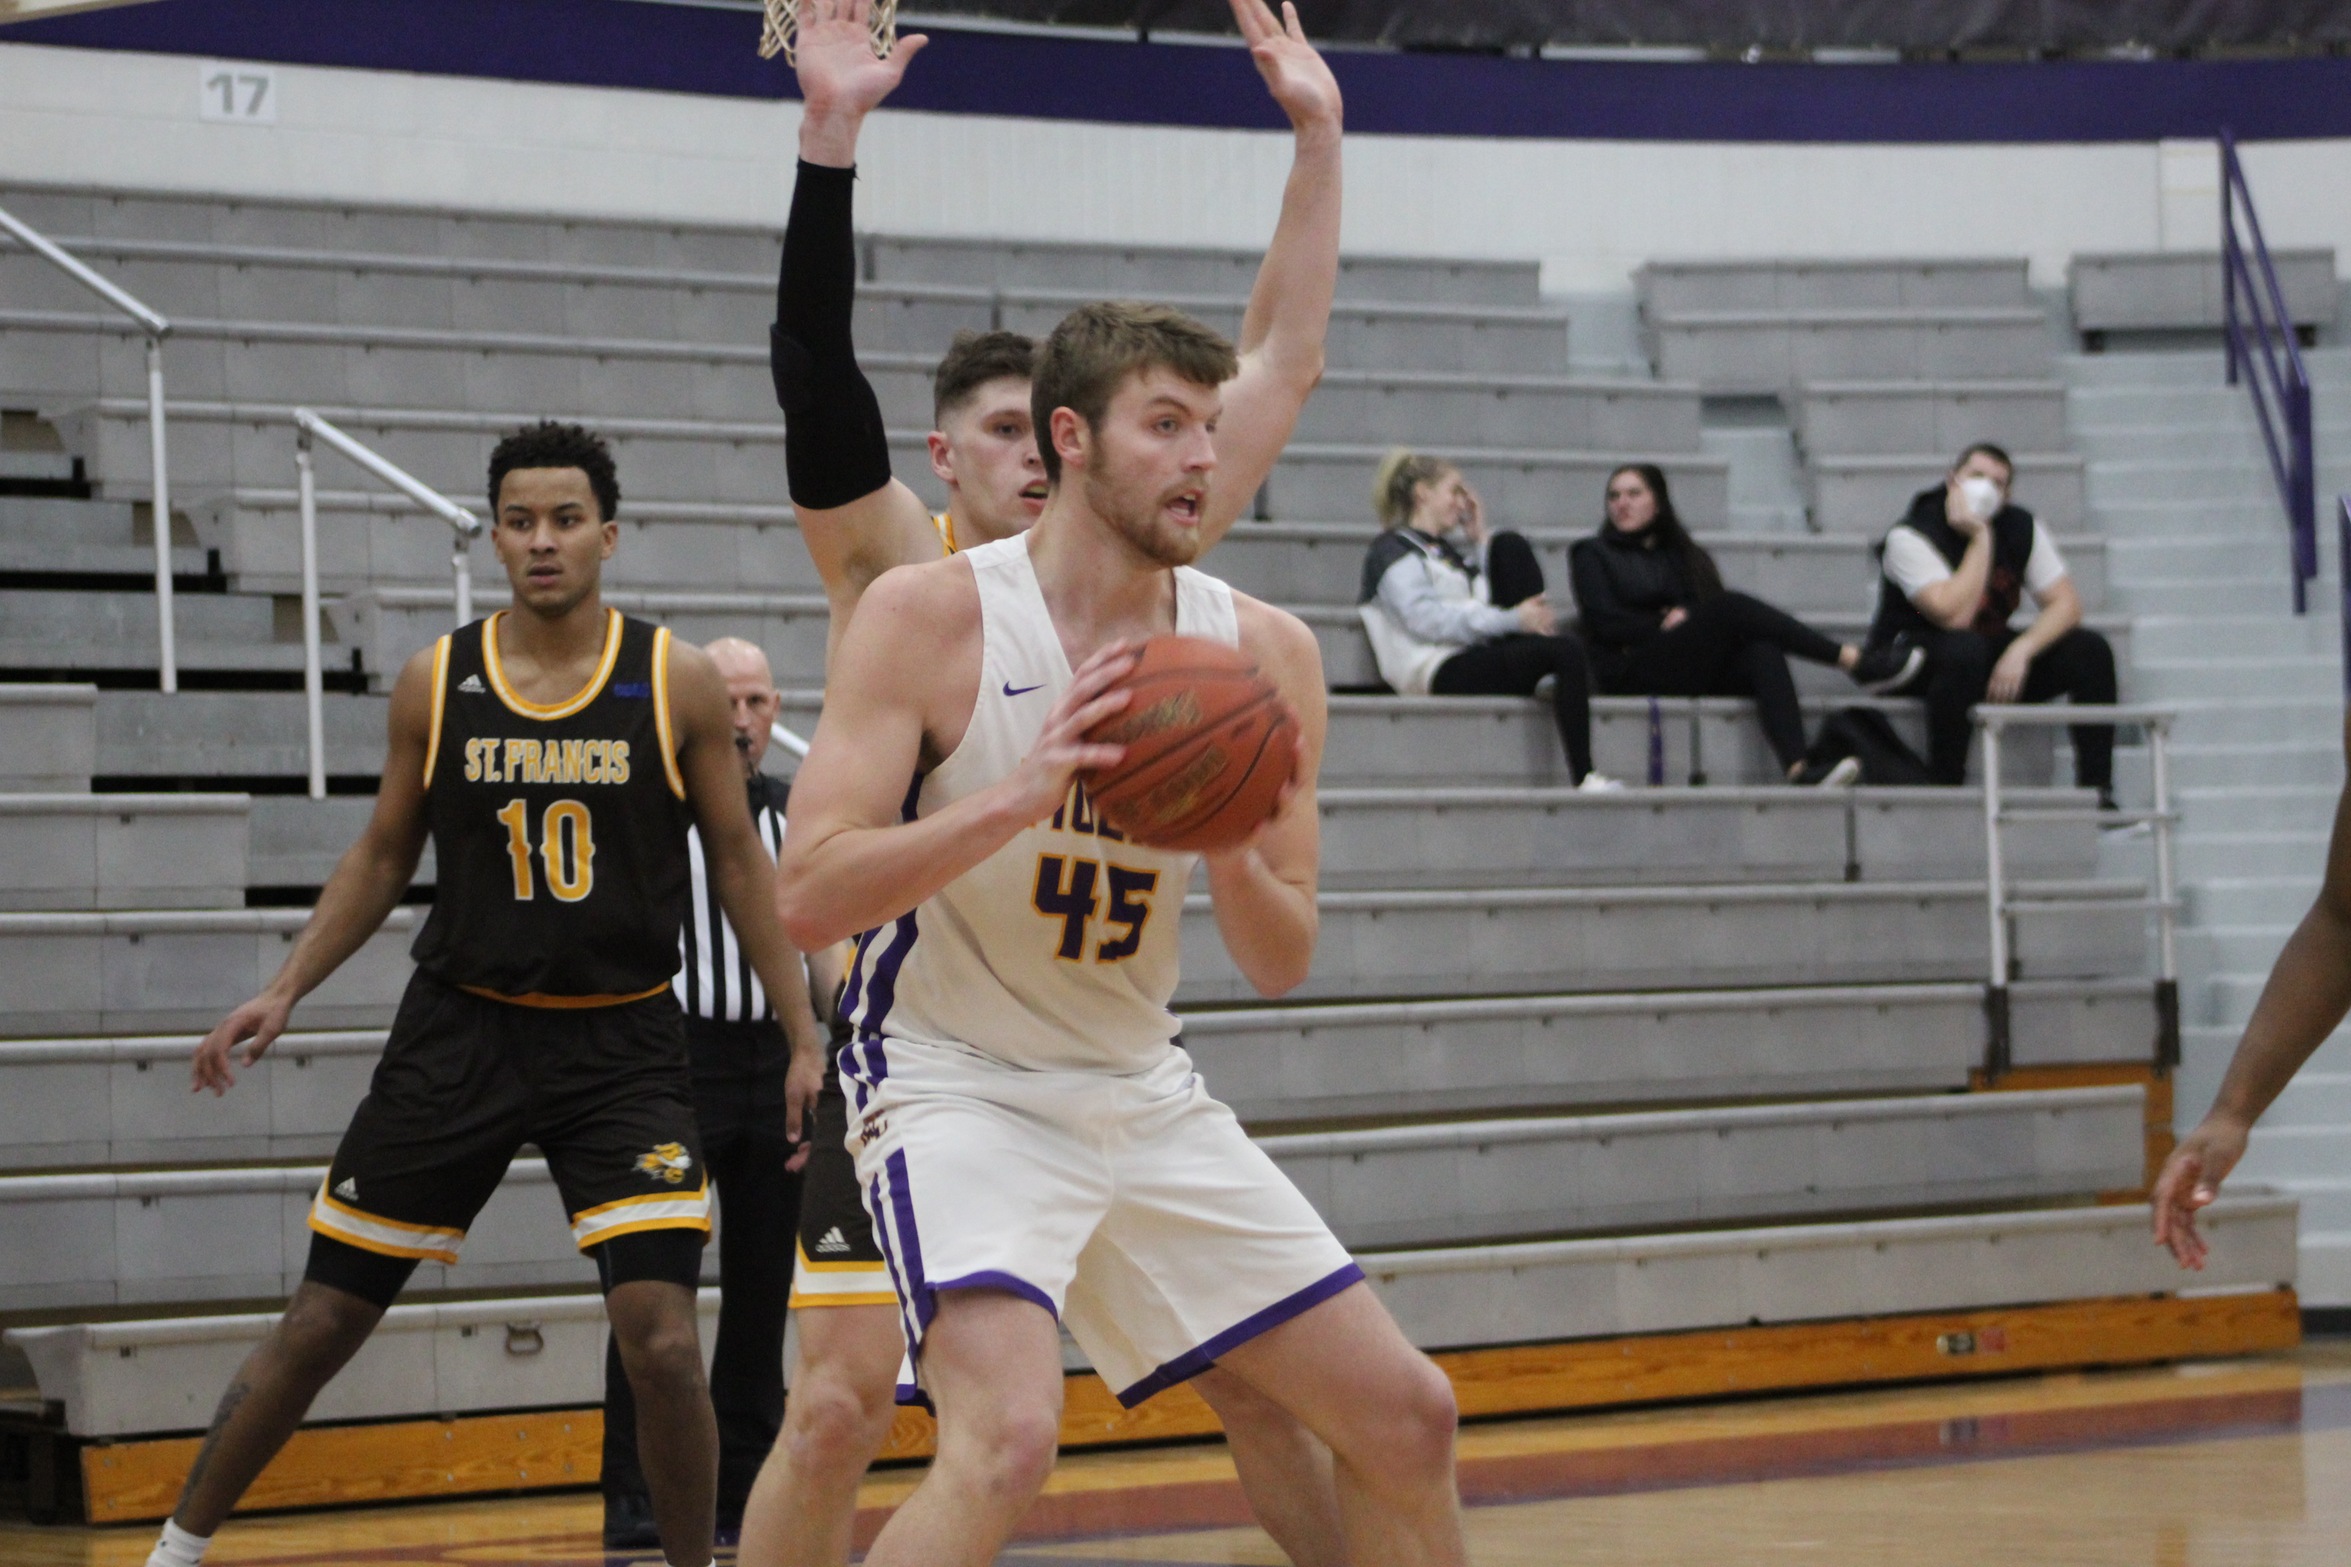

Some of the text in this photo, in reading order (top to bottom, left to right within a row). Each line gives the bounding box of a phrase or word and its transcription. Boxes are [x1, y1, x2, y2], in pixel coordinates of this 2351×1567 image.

[206, 73, 268, 116] 17
[496, 798, 596, 902] 10
[1030, 852, 1160, 964] 45
